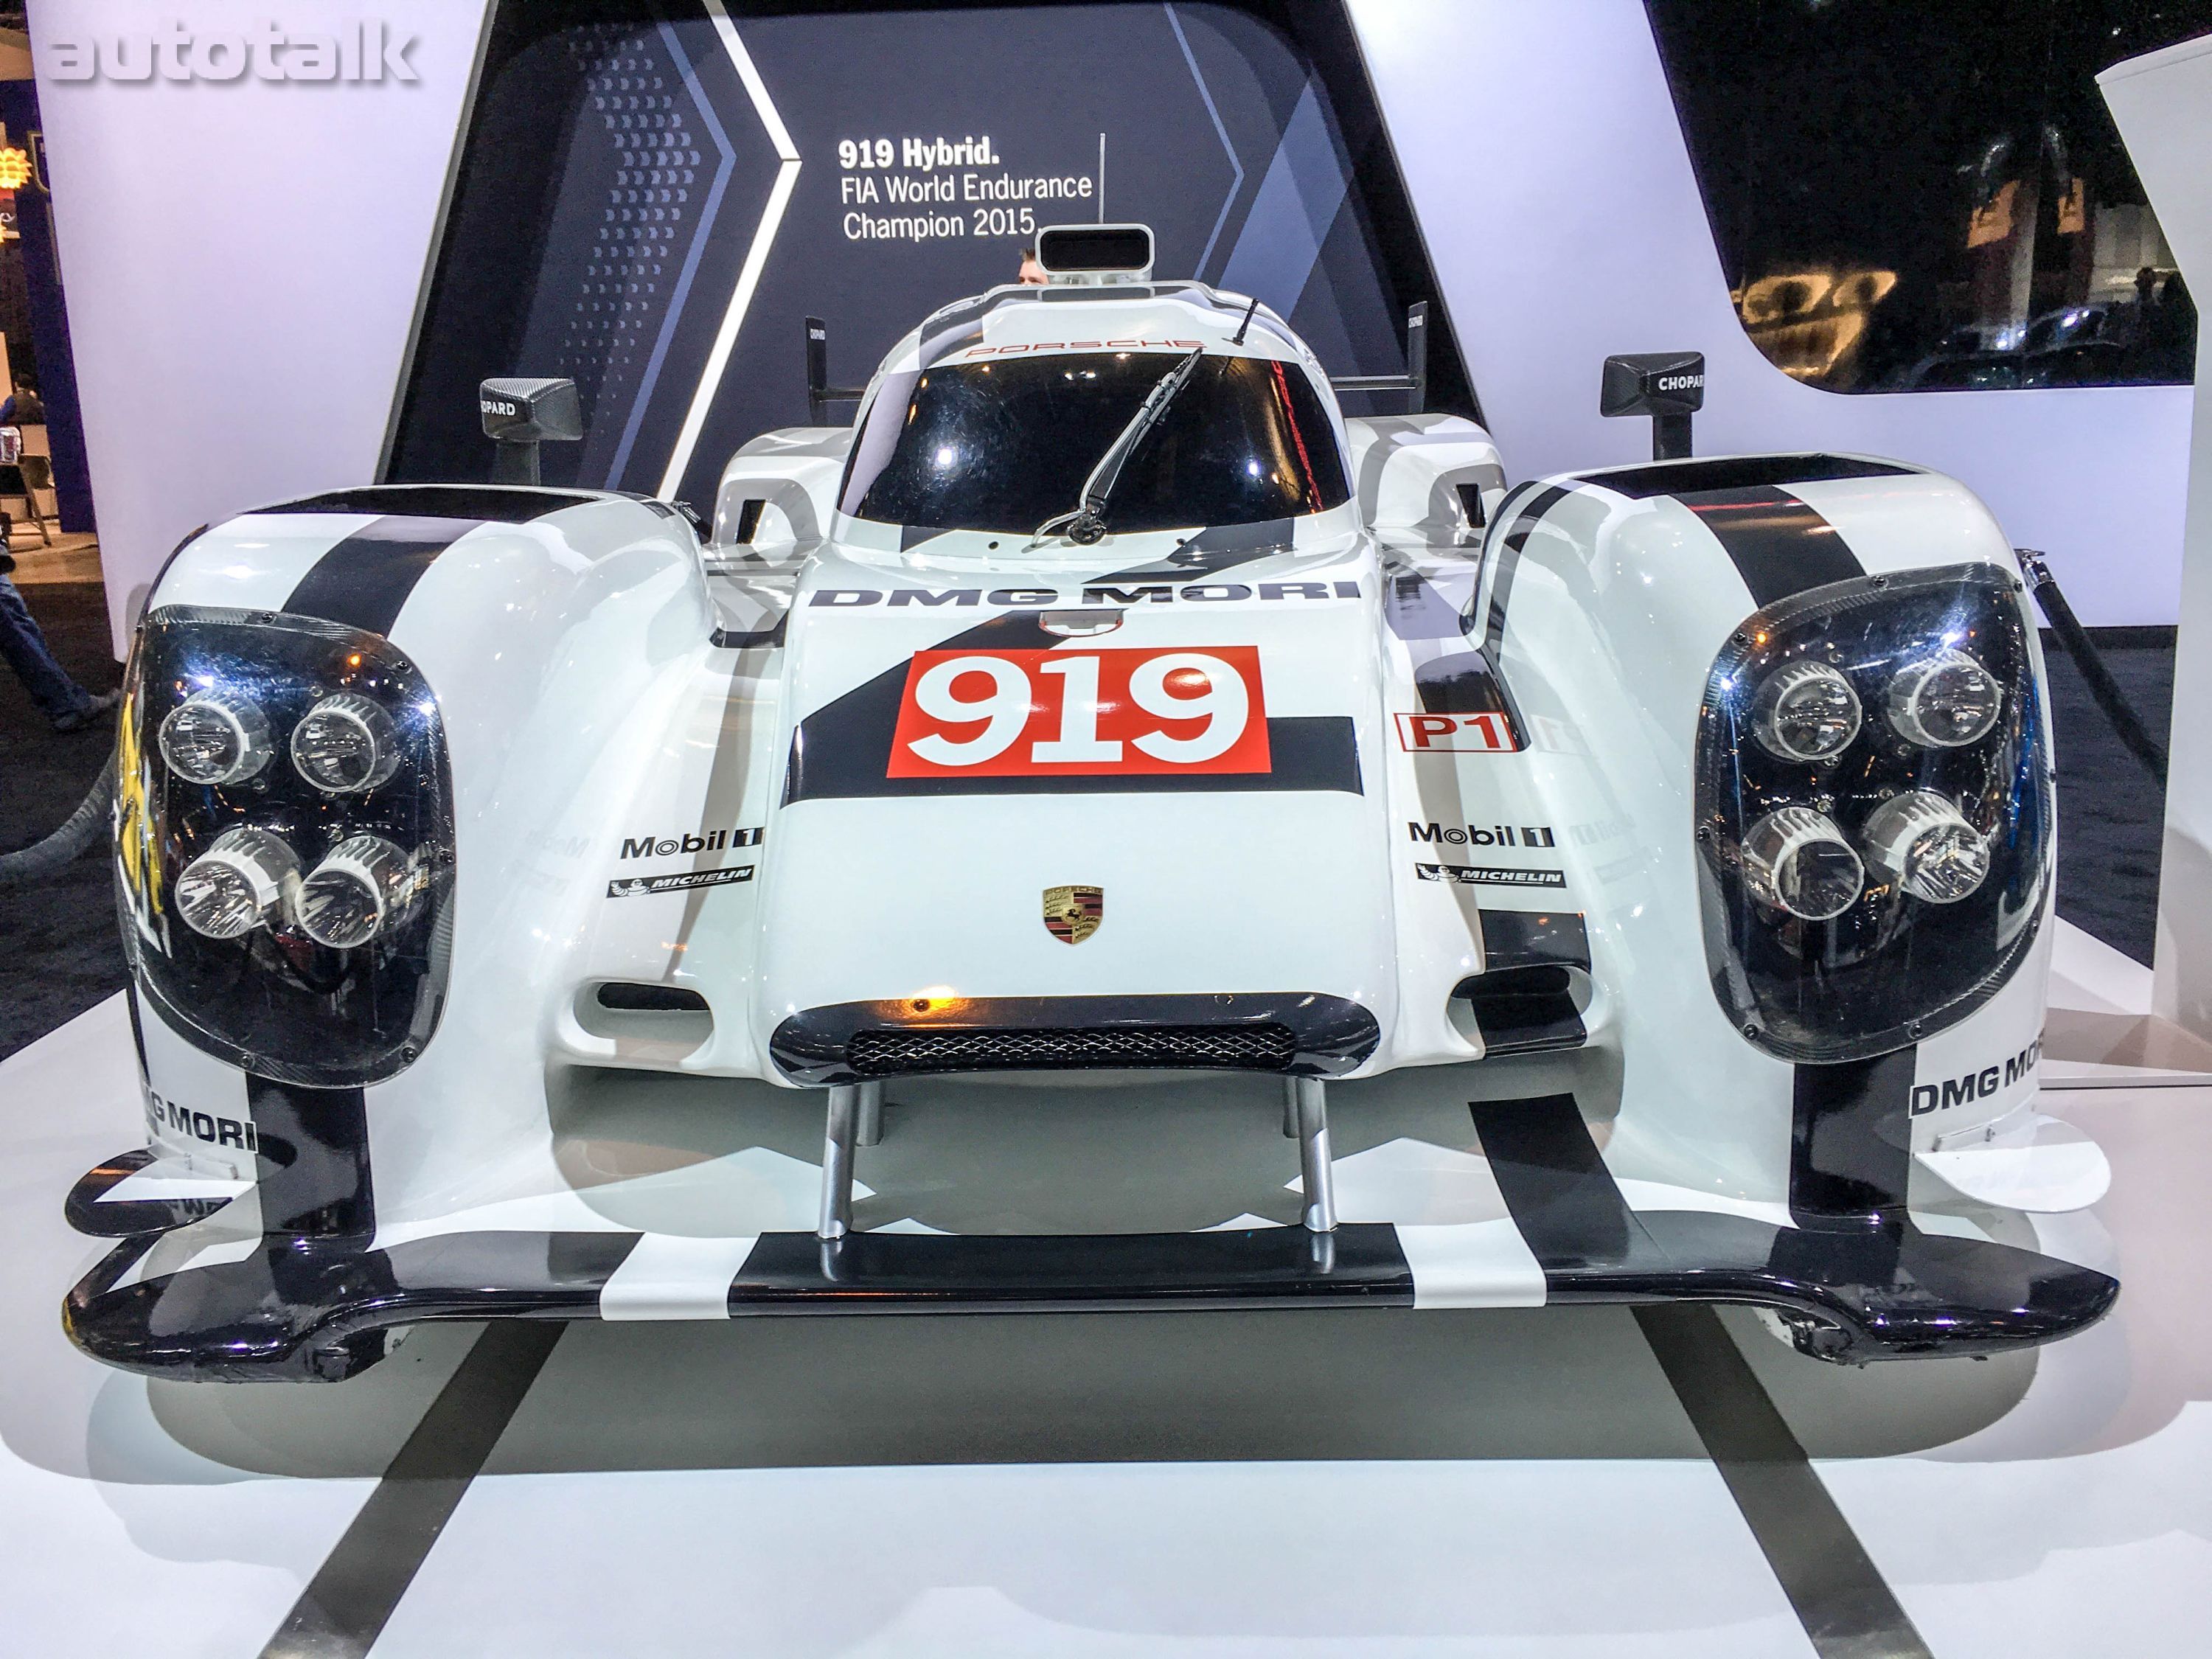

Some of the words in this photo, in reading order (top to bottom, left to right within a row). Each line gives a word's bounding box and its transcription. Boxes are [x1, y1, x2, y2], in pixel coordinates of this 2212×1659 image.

[838, 139, 894, 169] 919
[902, 136, 1000, 171] Hybrid.
[841, 176, 879, 204] FIA
[885, 175, 955, 204] World
[963, 173, 1093, 201] Endurance
[844, 211, 964, 243] Champion
[964, 340, 1208, 358] PORSCHE
[808, 588, 1060, 607] DMG
[1082, 582, 1362, 605] MORI
[907, 653, 1249, 766] 919
[1408, 715, 1501, 748] P1
[619, 830, 727, 859] Mobil
[1408, 821, 1516, 846] Mobil
[651, 868, 753, 888] MICHELIN
[1461, 869, 1562, 883] MICHELIN
[1911, 1065, 2000, 1116] DMG
[167, 1100, 257, 1152] MORI
